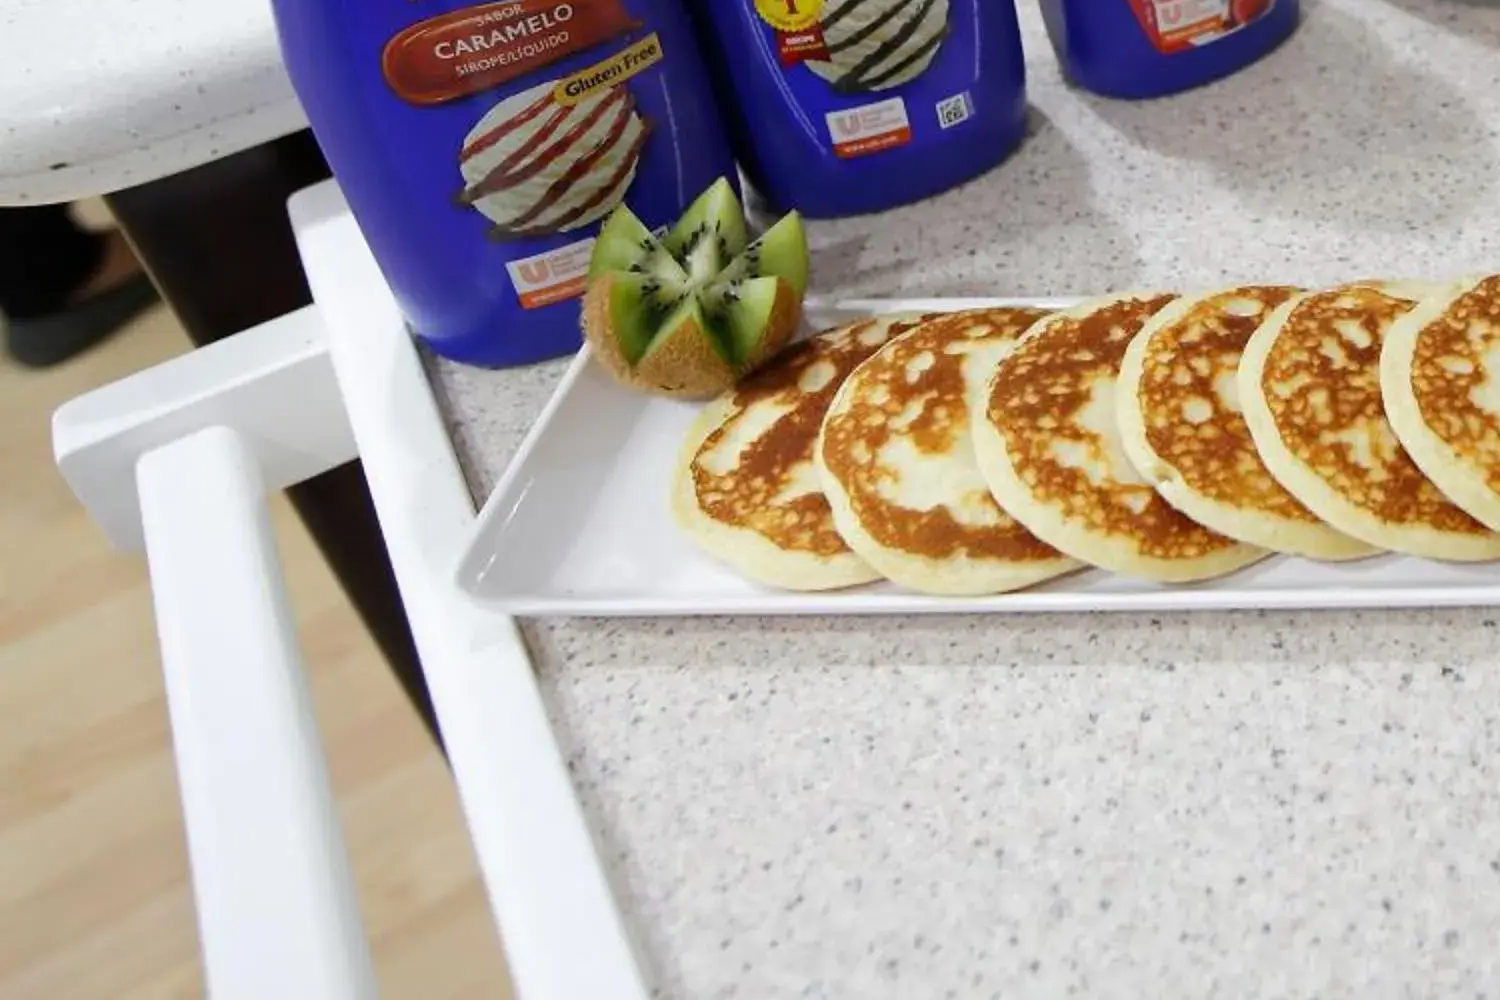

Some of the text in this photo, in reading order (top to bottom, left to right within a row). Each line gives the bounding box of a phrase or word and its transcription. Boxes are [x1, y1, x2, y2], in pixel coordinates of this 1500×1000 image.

[434, 3, 574, 60] CARAMELO
[476, 3, 524, 26] SABOR
[564, 42, 658, 98] Gluten Free
